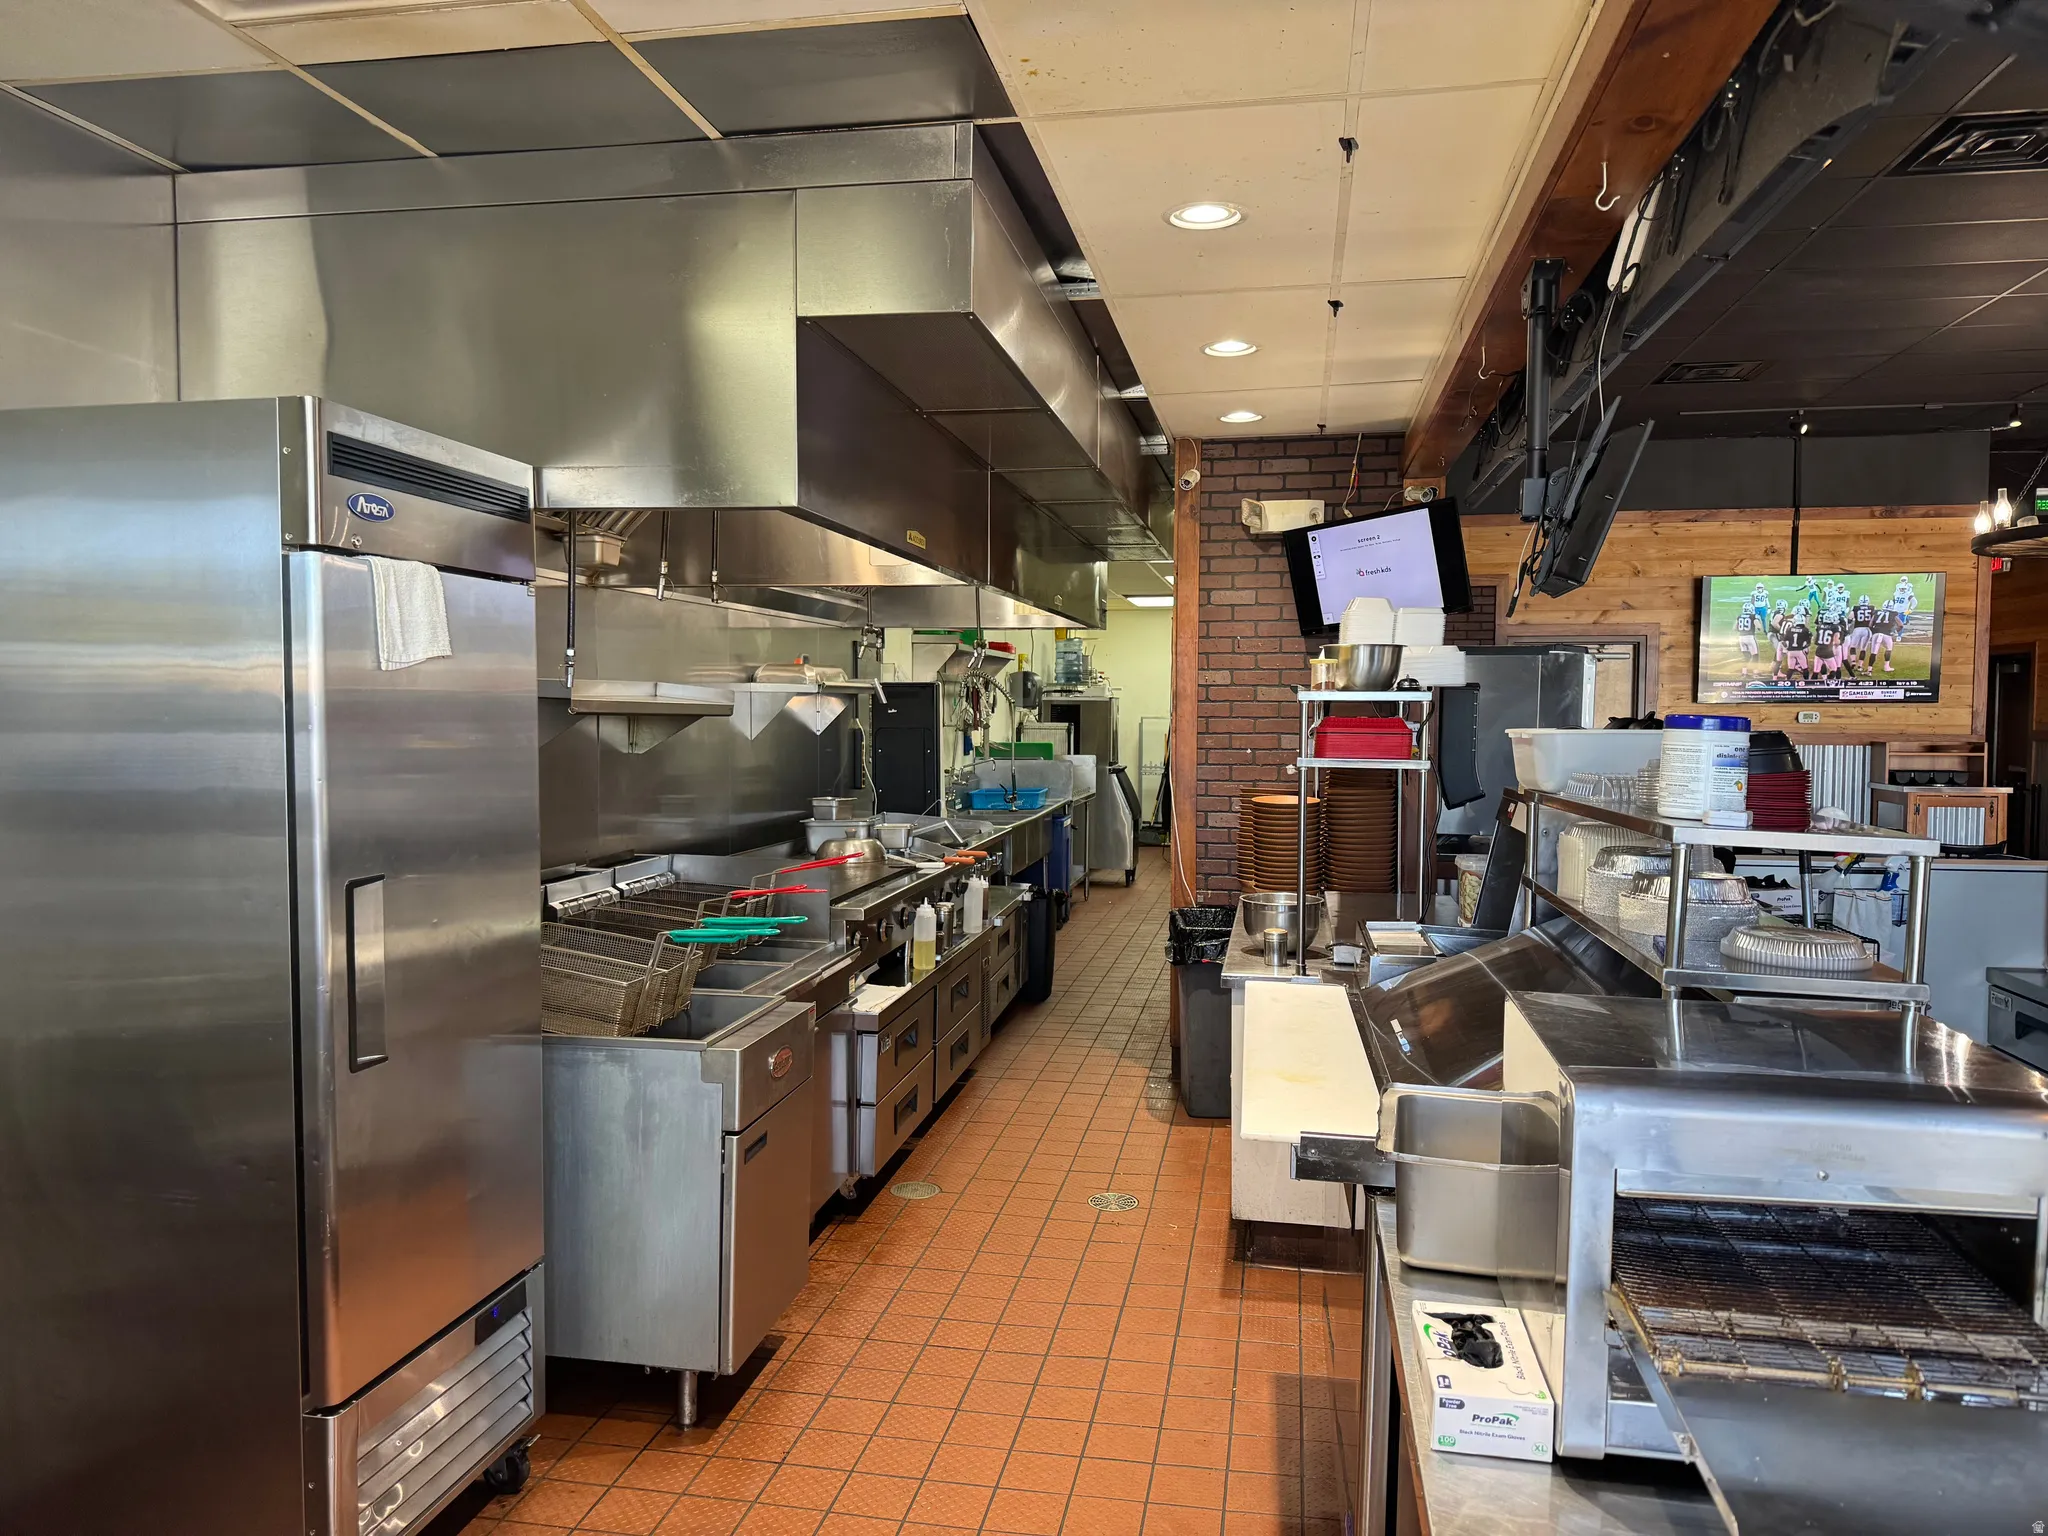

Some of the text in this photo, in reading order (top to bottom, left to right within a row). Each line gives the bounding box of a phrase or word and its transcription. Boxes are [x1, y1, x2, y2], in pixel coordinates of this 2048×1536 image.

[1365, 567, 1381, 576] fresh
[1857, 609, 1872, 622] 65
[1875, 611, 1890, 624] 71
[1738, 618, 1751, 631] 89
[1792, 633, 1798, 647] 1
[1818, 629, 1833, 645] 16
[1472, 1413, 1513, 1427] ProPak
[1439, 1435, 1455, 1444] 100
[1507, 1433, 1526, 1441] Gloves
[1534, 1444, 1548, 1453] XL
